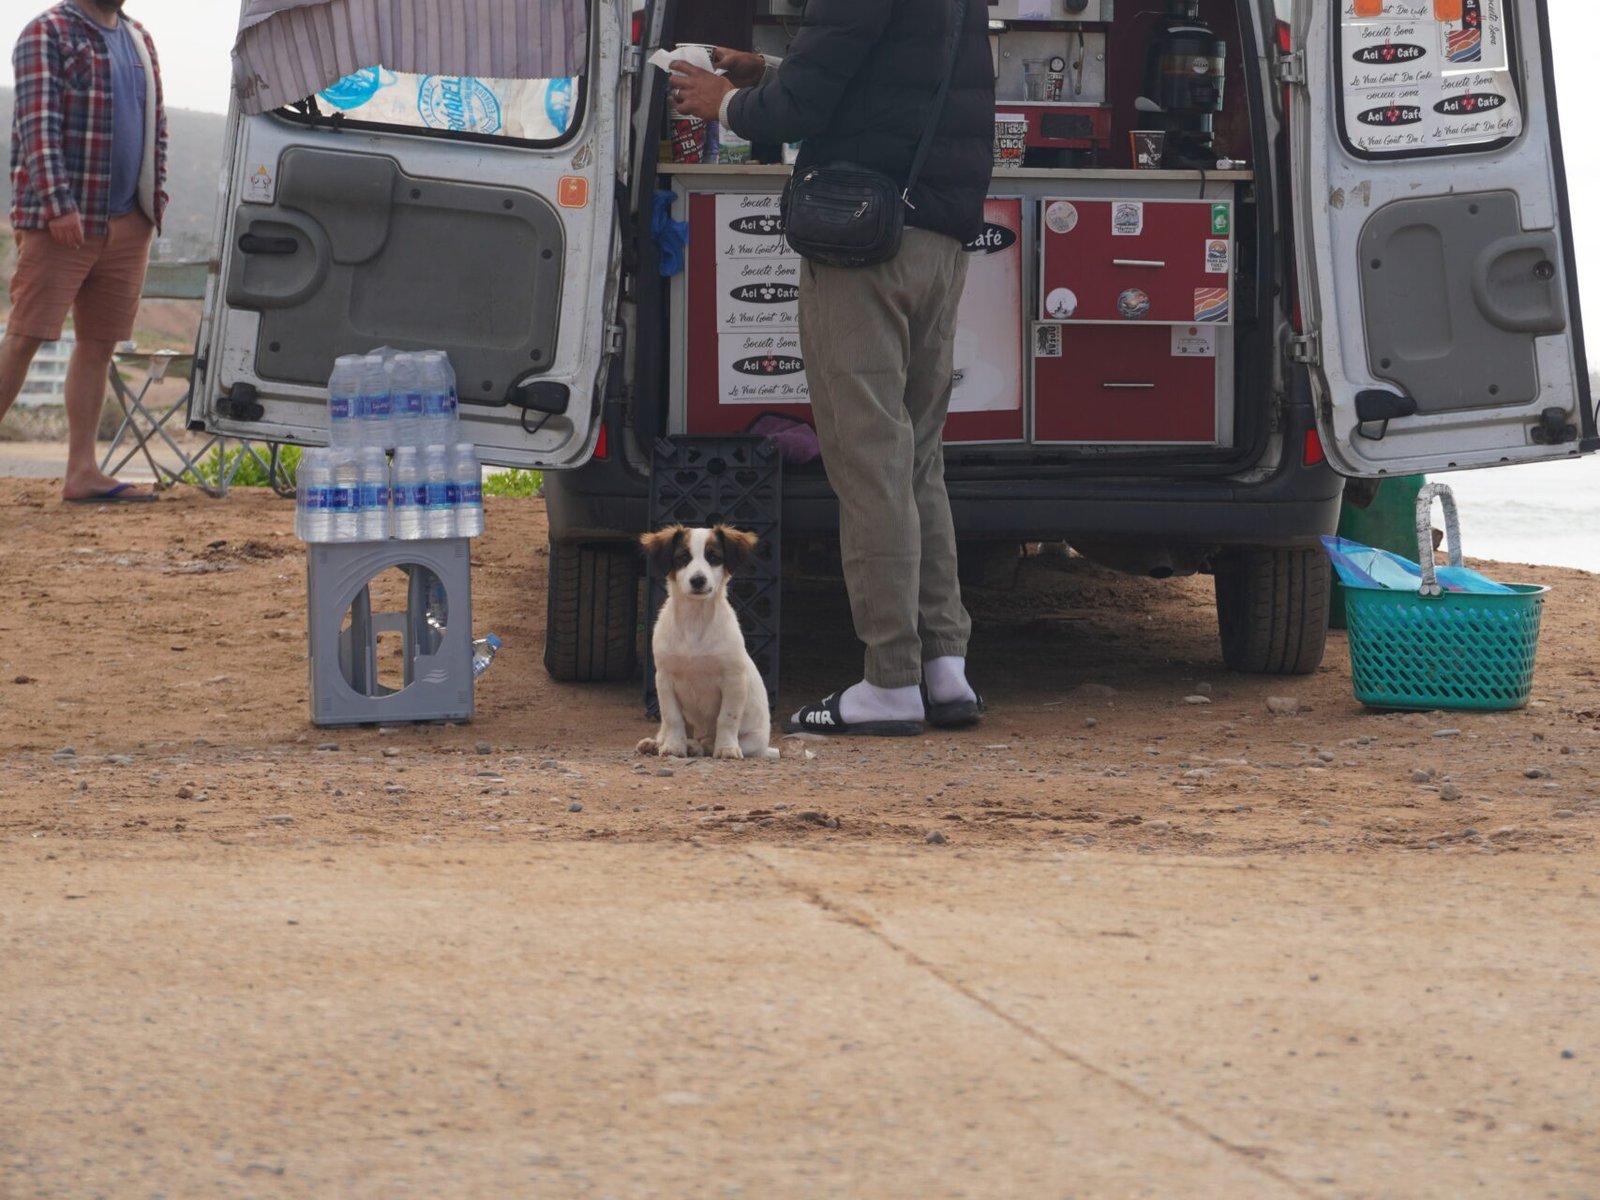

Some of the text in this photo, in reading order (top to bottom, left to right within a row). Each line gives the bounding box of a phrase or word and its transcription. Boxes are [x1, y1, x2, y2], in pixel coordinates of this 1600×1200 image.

[1397, 46, 1419, 58] Café
[1401, 71, 1413, 82] Du
[1477, 96, 1499, 107] Café
[1483, 121, 1495, 132] Du
[681, 138, 697, 150] TEA
[1406, 133, 1419, 144] Du
[966, 228, 1003, 247] afé
[777, 287, 799, 298] Café
[780, 311, 792, 322] Du
[778, 360, 800, 370] Café
[781, 383, 794, 394] Du
[805, 710, 835, 725] AIR
